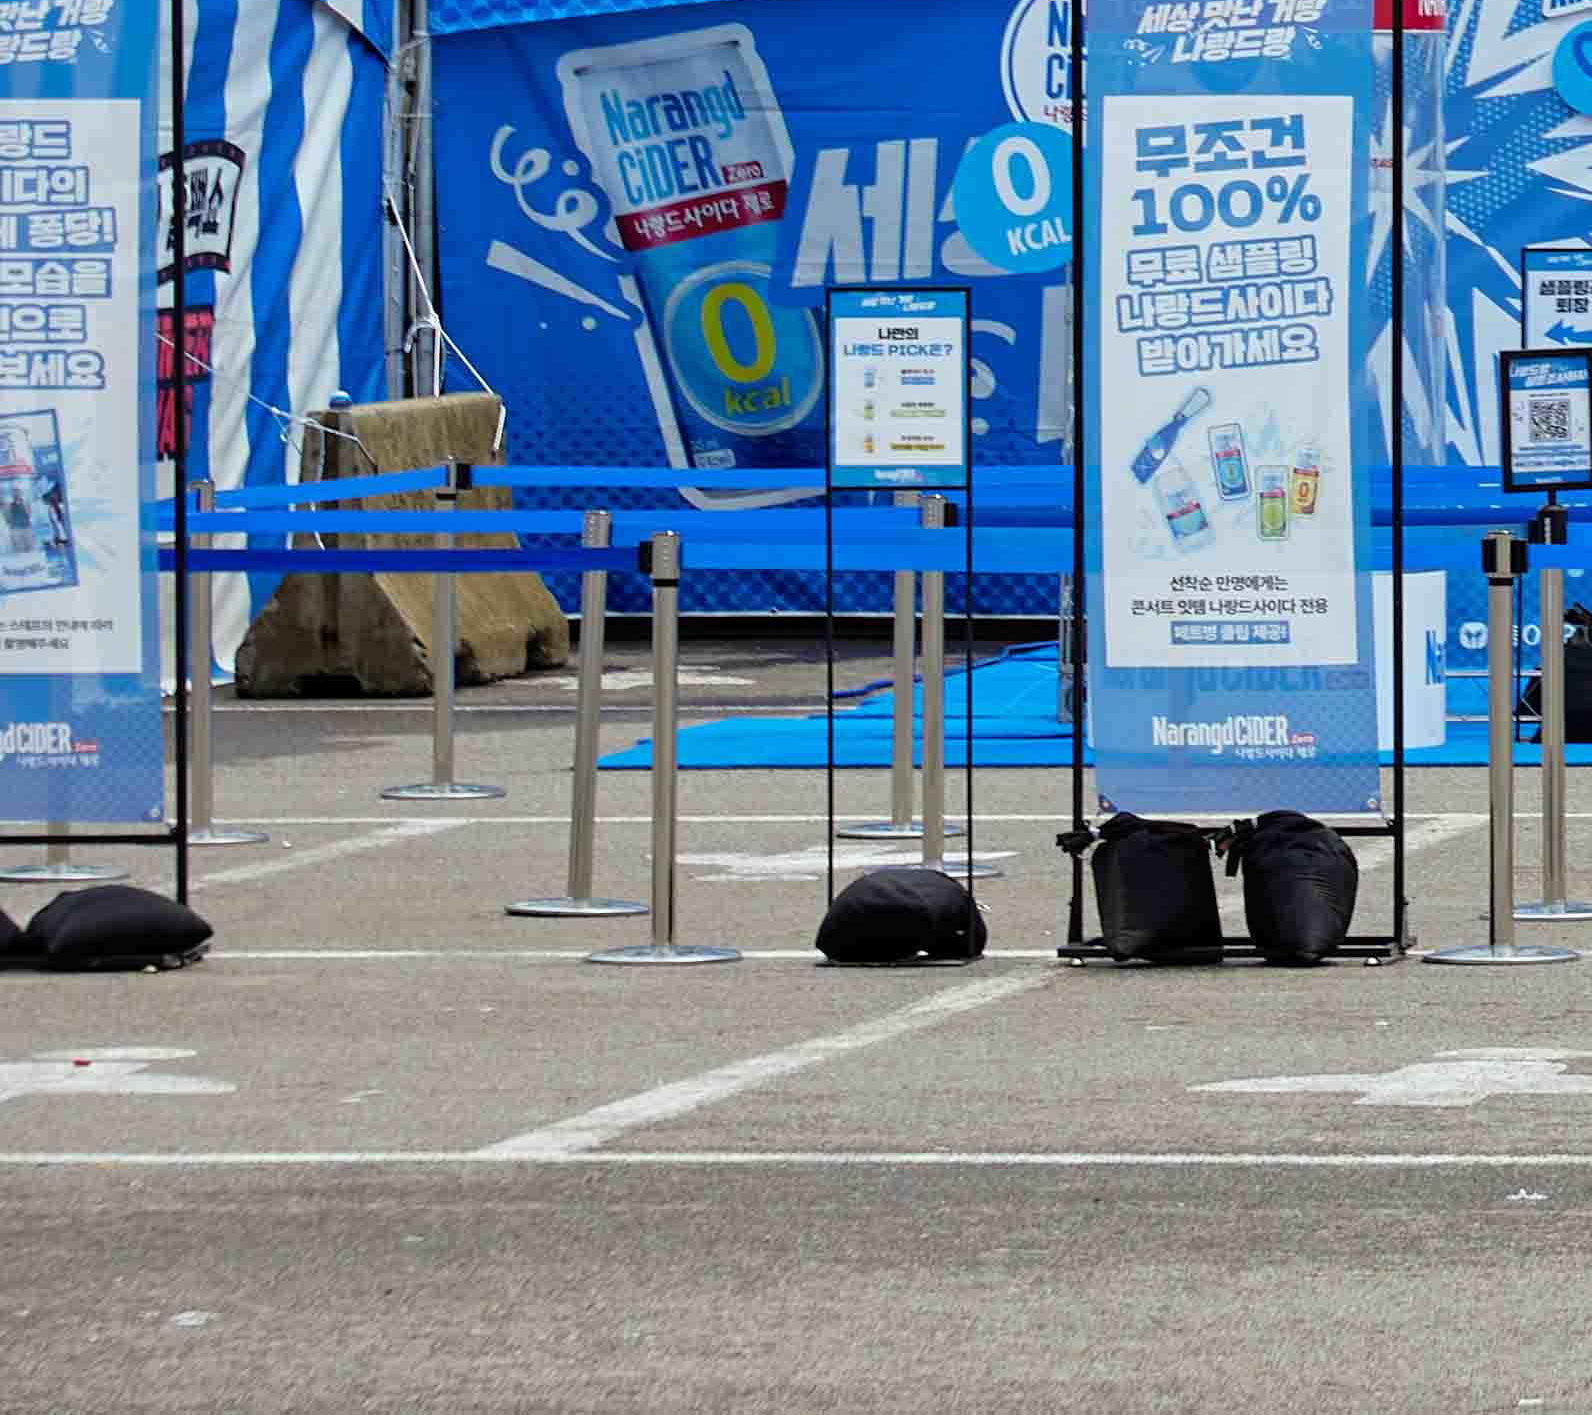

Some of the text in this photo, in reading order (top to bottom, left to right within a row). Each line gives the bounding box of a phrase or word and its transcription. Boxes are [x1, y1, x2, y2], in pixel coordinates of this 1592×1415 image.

[1137, 1, 1199, 34] 세상
[1172, 26, 1295, 63] 나랑드랑
[600, 70, 745, 145] Narangd
[1135, 114, 1307, 178] 무조건
[992, 137, 1051, 216] 0
[634, 192, 774, 240] 나랑드사이다 제로
[1132, 173, 1322, 235] 100%
[1007, 217, 1072, 255] KCAL
[1128, 235, 1318, 287] 무료 샘플링
[1116, 277, 1333, 331] 나랑드사이다
[1556, 298, 1589, 313] 퇴장
[702, 282, 775, 382] 0
[1136, 324, 1319, 375] 받아가세요
[725, 376, 790, 416] kcal
[1131, 599, 1174, 615] 콘서트
[1209, 598, 1296, 615] 나랑드사이다
[1300, 598, 1328, 614] 전용
[1170, 575, 1288, 592] 선착순 만명에게는
